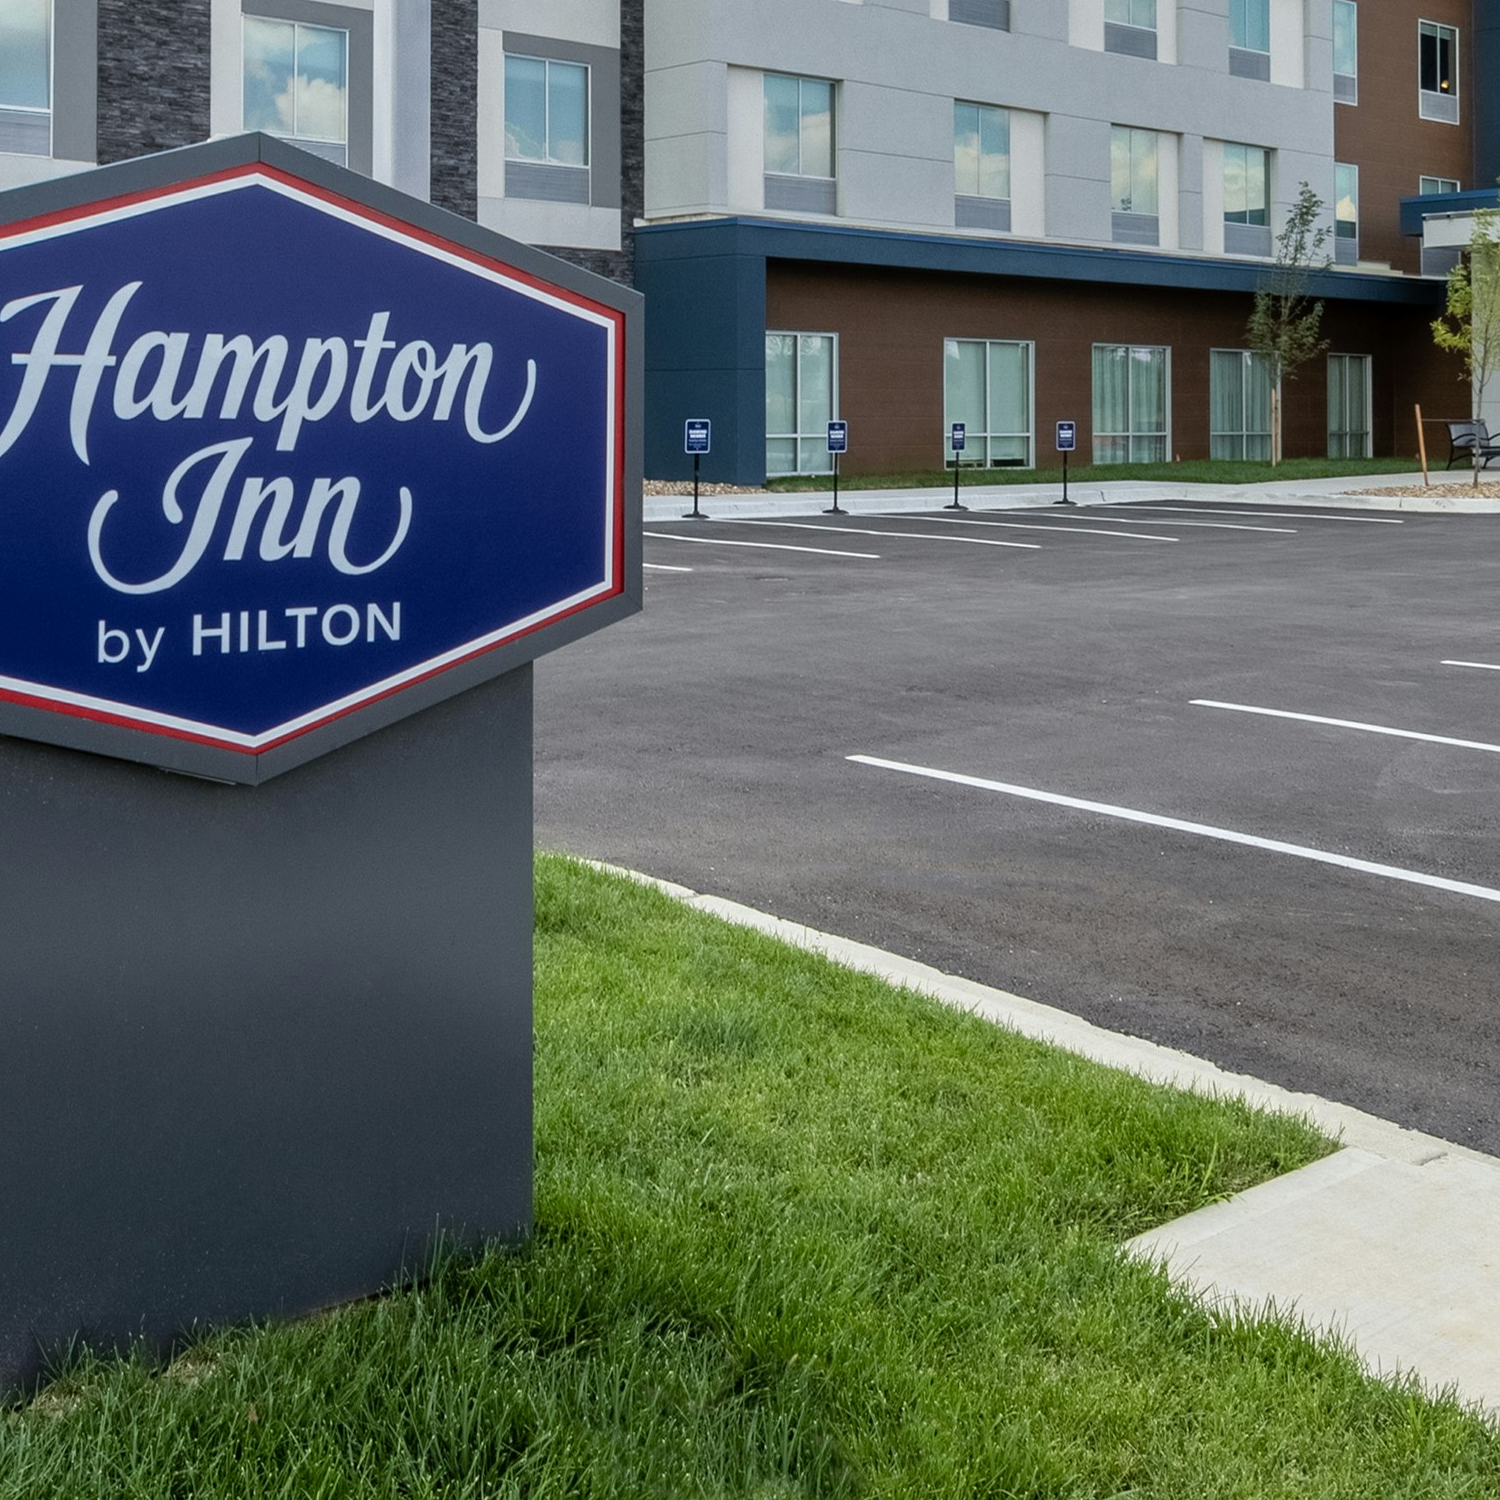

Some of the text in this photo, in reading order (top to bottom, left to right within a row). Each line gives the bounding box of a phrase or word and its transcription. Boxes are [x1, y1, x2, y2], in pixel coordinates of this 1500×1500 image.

[87, 436, 413, 595] Inn
[97, 601, 402, 673] by HILTON
